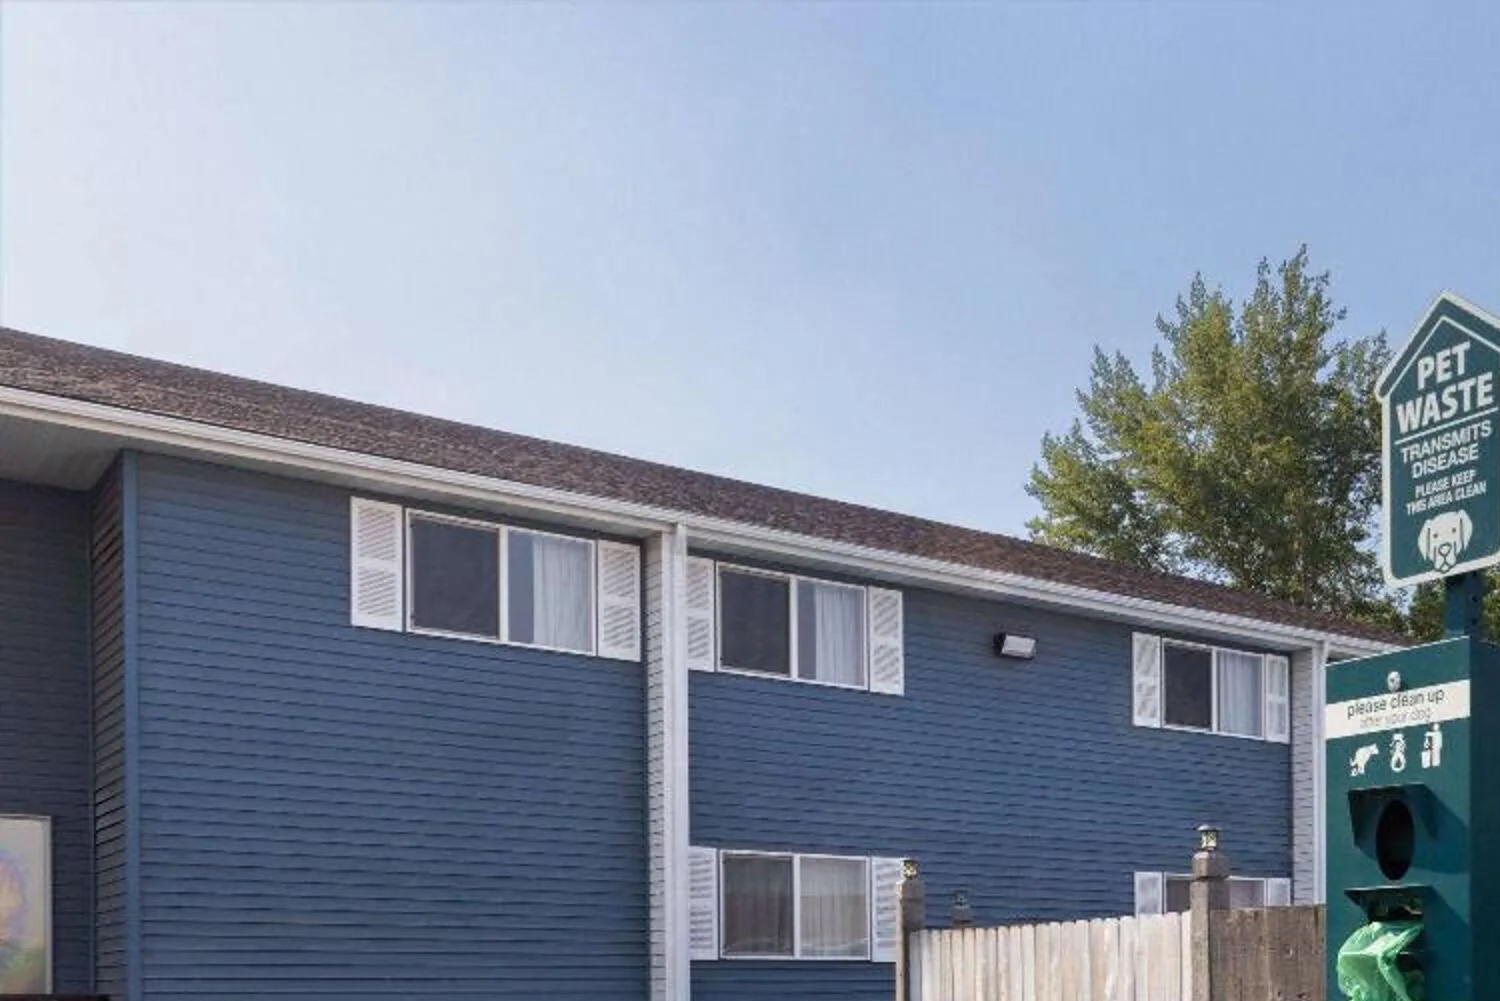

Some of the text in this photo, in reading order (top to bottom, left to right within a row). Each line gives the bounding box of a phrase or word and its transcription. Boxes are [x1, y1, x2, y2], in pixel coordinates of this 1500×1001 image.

[1418, 341, 1471, 390] PET
[1396, 372, 1494, 433] WASTE
[1401, 420, 1492, 464] TRANSMITS
[1412, 442, 1479, 479] DISEASE
[1406, 480, 1488, 517] THIS AREA CLEAN
[1415, 469, 1476, 499] PLEASE KEEP
[1347, 688, 1445, 721] please clean up
